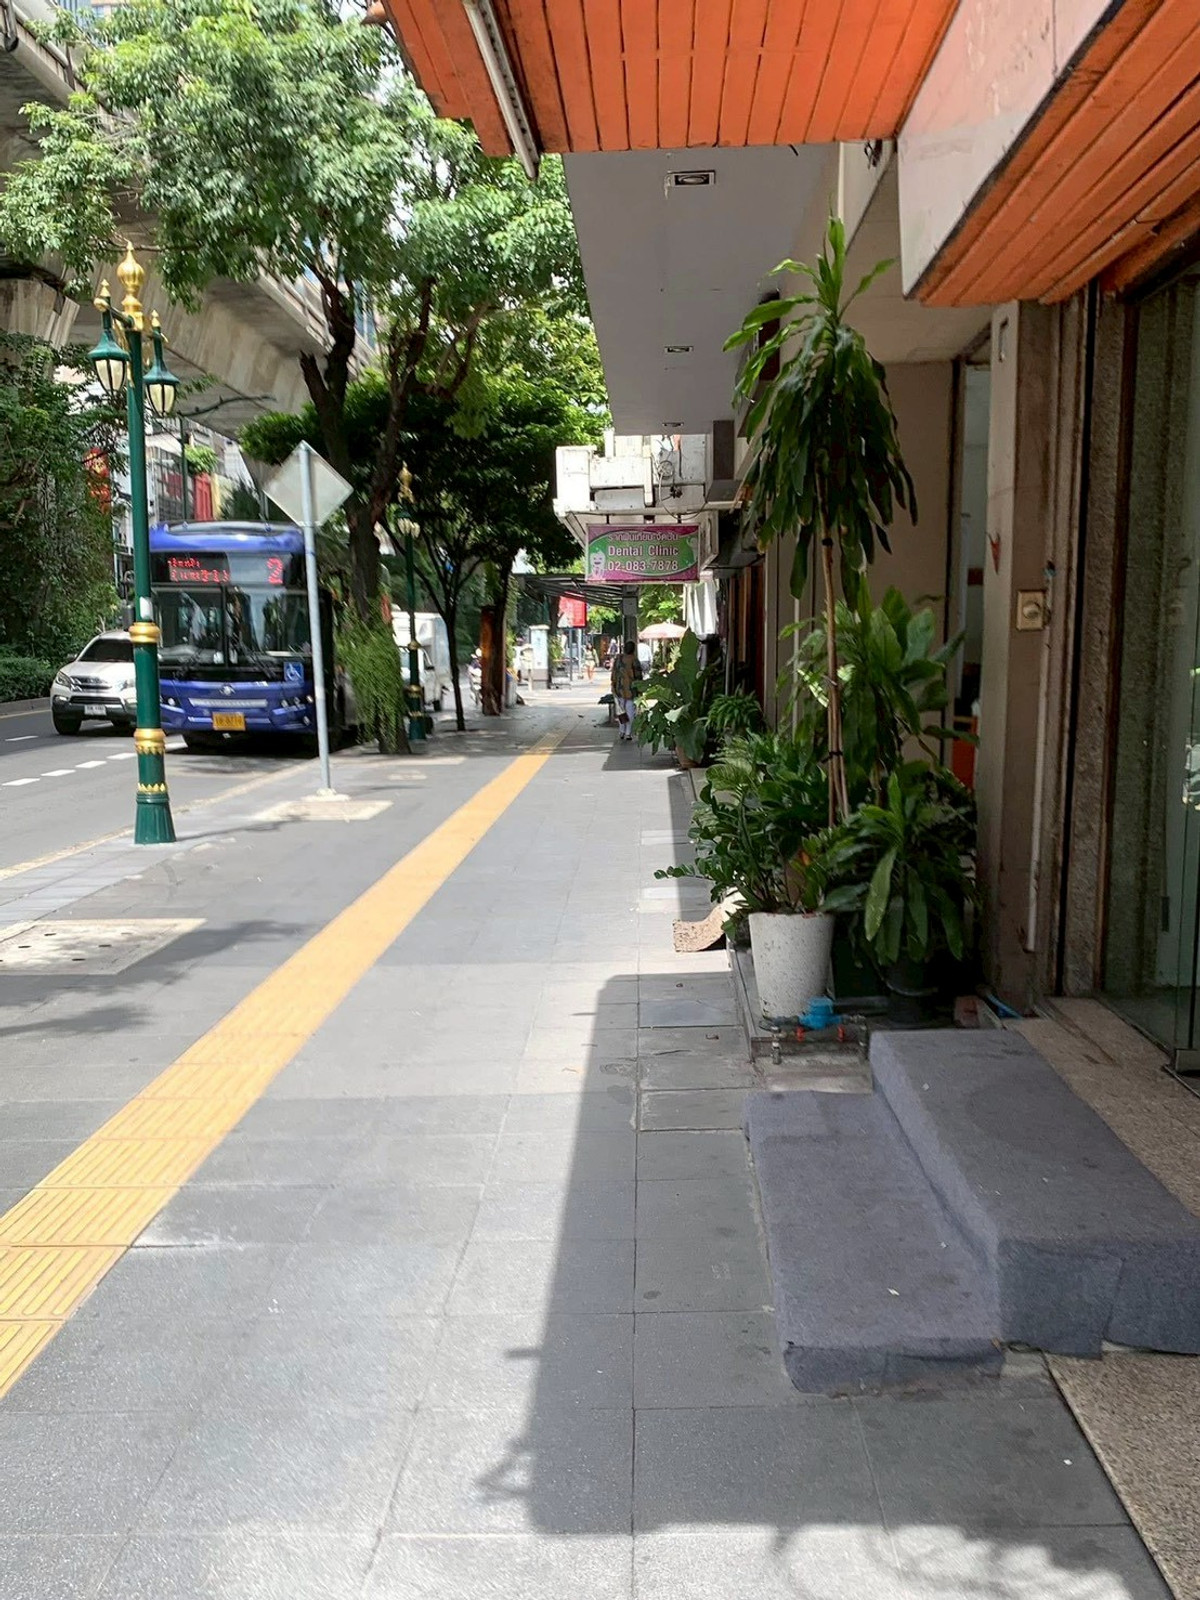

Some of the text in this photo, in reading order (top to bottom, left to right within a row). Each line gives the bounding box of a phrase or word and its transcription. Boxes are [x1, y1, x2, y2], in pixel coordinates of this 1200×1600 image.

[608, 545, 679, 556] Dental Clinic
[607, 560, 679, 570] 02-083-7878
